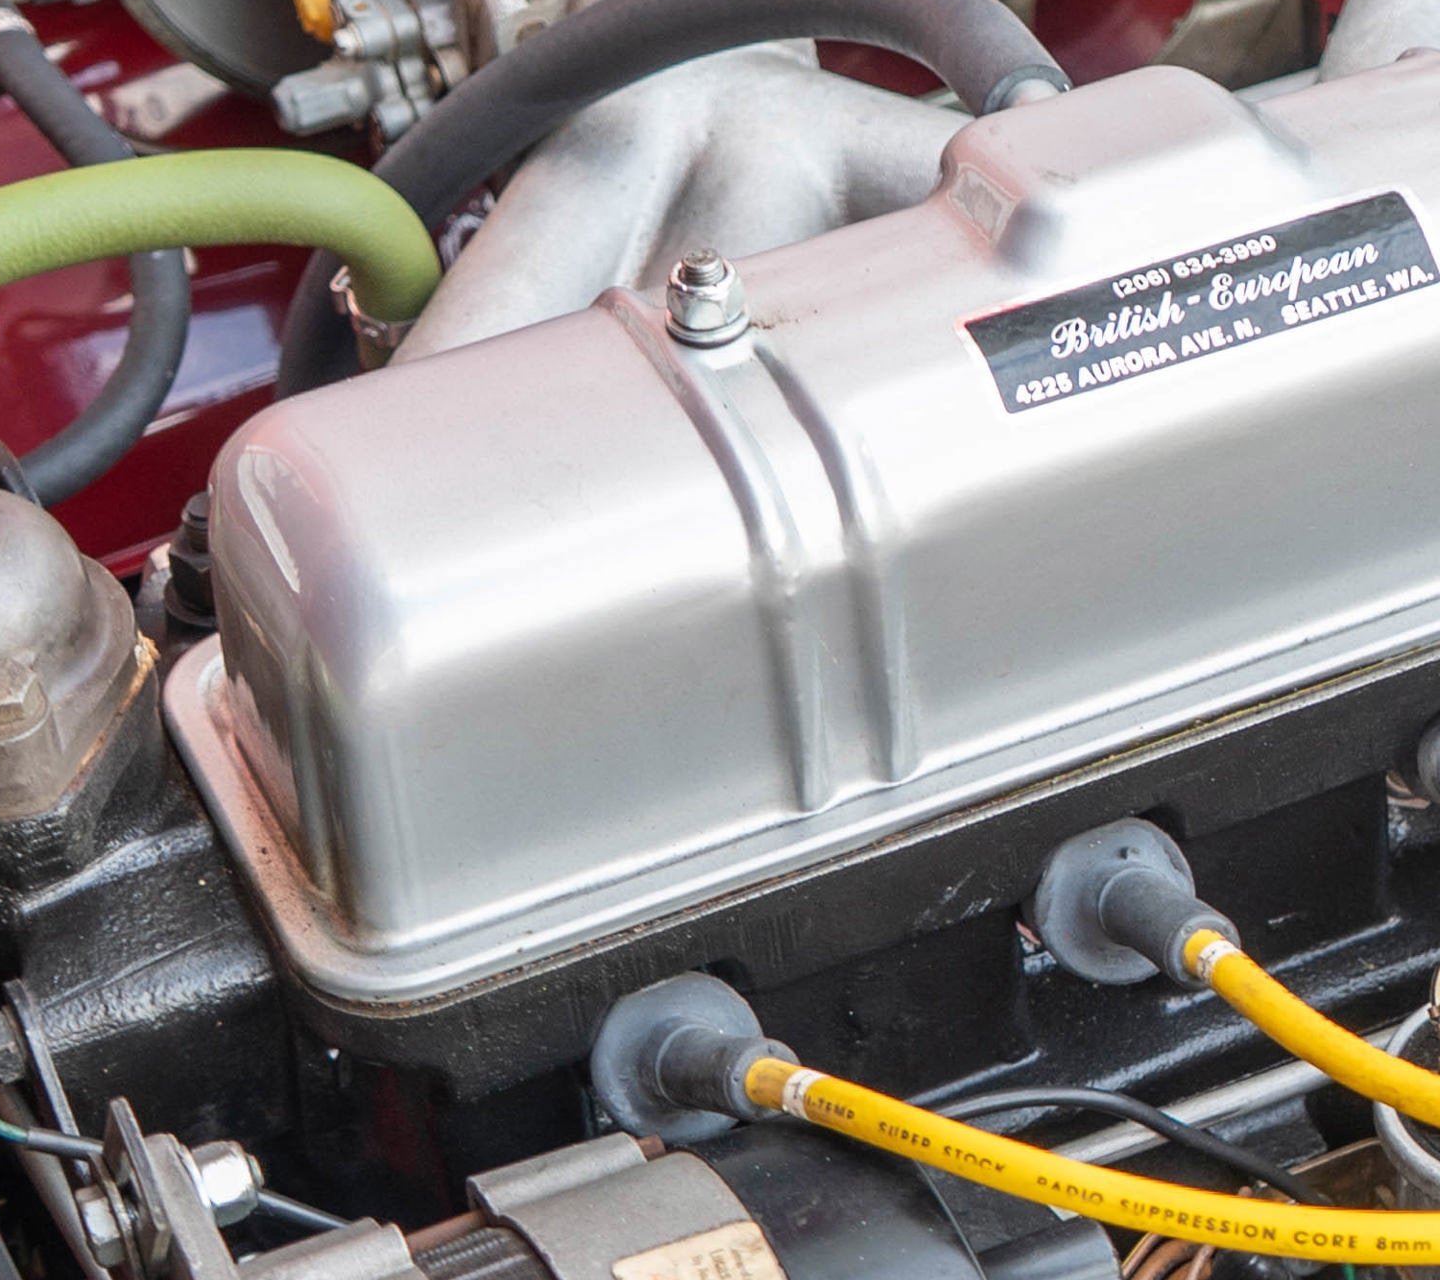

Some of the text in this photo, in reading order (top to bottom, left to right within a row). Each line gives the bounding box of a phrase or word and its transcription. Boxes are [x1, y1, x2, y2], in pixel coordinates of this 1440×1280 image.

[1077, 341, 1177, 388] AURORA
[1180, 327, 1234, 358] AVE.
[1233, 317, 1262, 341] N.
[1280, 283, 1387, 326] SEATTLE,
[1386, 266, 1435, 297] WA.
[1112, 234, 1278, 299] (206) 634-3990
[808, 1094, 856, 1120] I-TEMP
[1120, 1198, 1278, 1241] SUPPRESSION
[1293, 1230, 1359, 1249] CORE
[1377, 1236, 1432, 1252] 8mm
